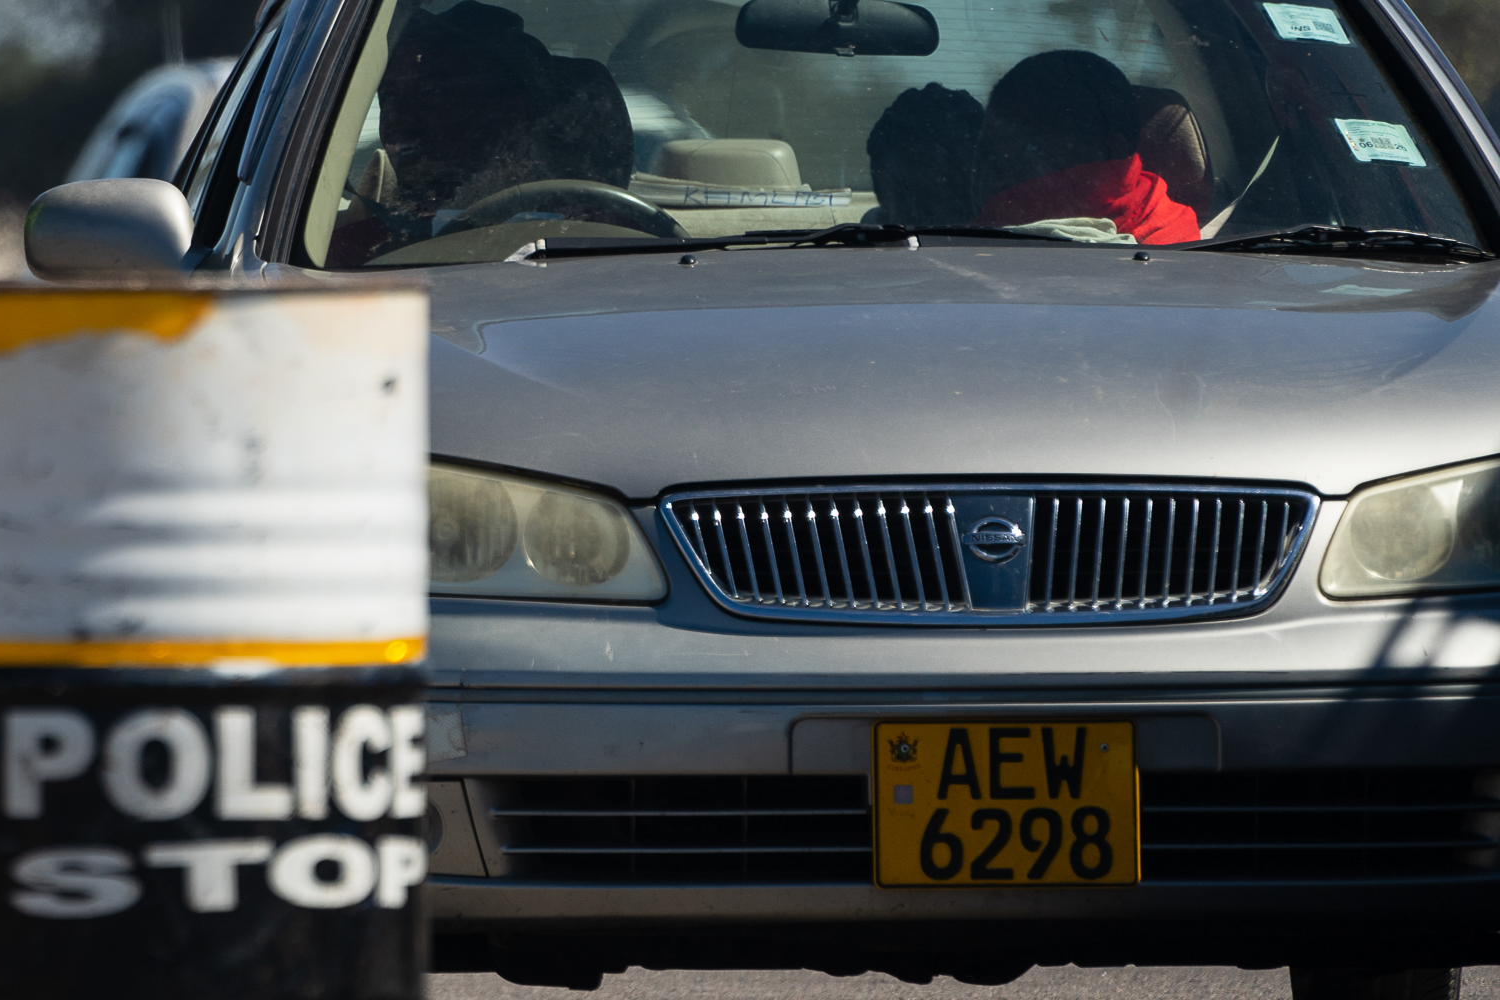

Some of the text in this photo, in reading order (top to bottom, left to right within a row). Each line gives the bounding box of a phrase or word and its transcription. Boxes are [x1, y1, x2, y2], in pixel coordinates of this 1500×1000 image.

[971, 534, 1021, 542] NISSAN
[2, 703, 426, 822] POLICE
[937, 727, 1087, 800] AEW
[8, 834, 428, 920] STOP
[920, 806, 1113, 880] 6298
